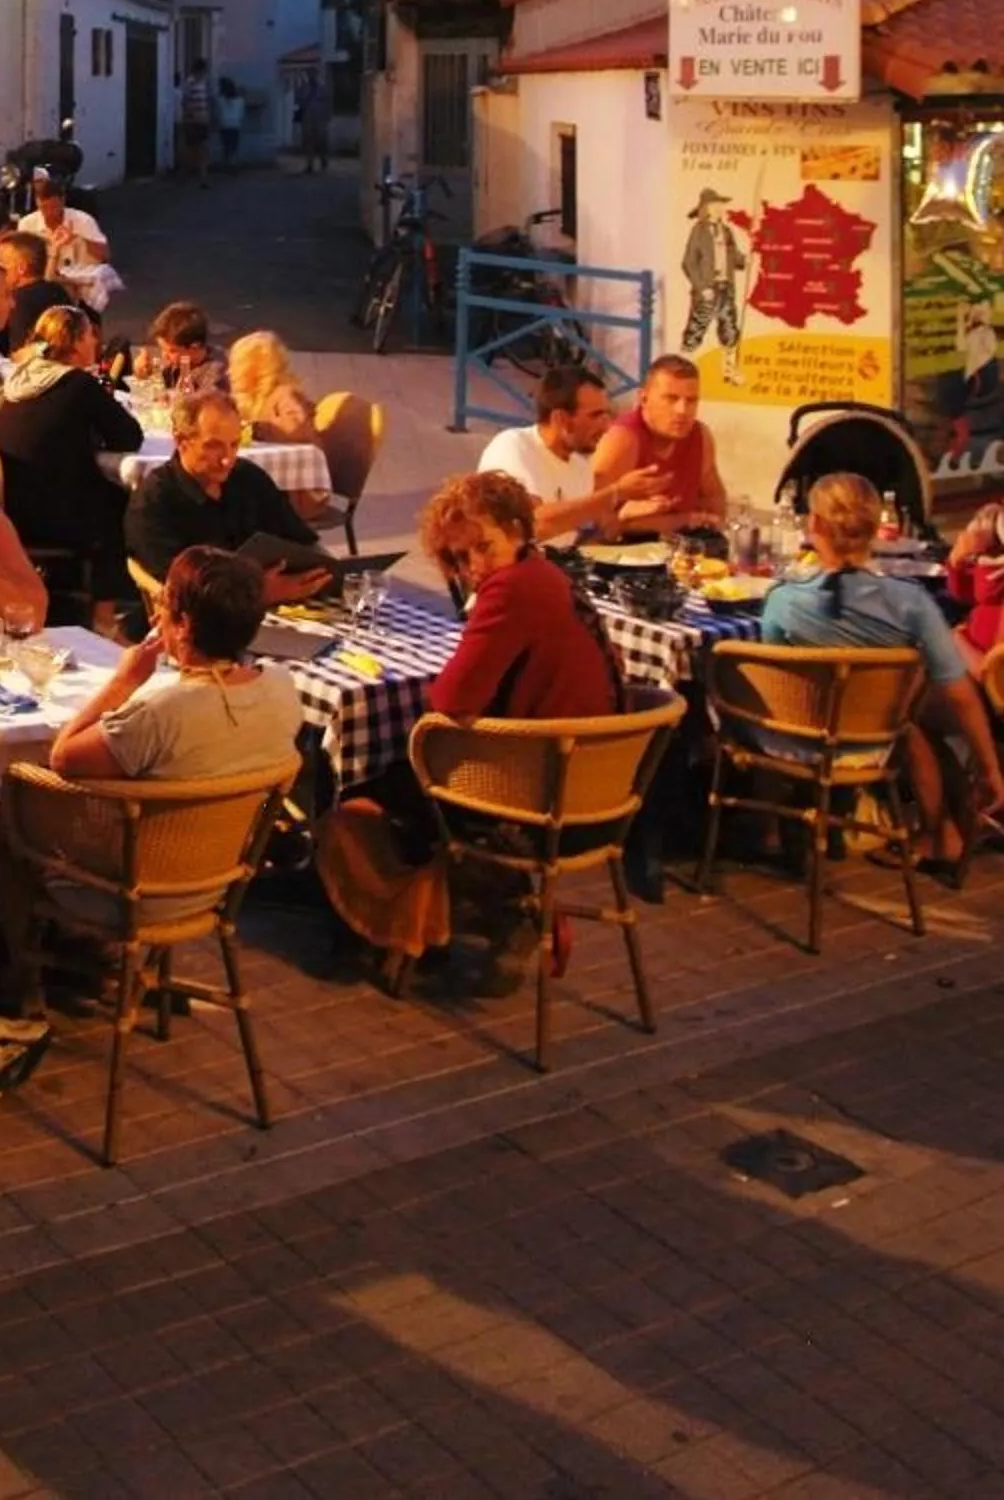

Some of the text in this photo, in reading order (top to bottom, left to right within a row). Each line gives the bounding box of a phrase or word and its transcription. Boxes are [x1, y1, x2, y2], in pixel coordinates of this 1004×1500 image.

[718, 2, 794, 23] Châte
[697, 26, 752, 45] Marie
[756, 26, 780, 45] du
[698, 57, 820, 76] EN VENTE ICI
